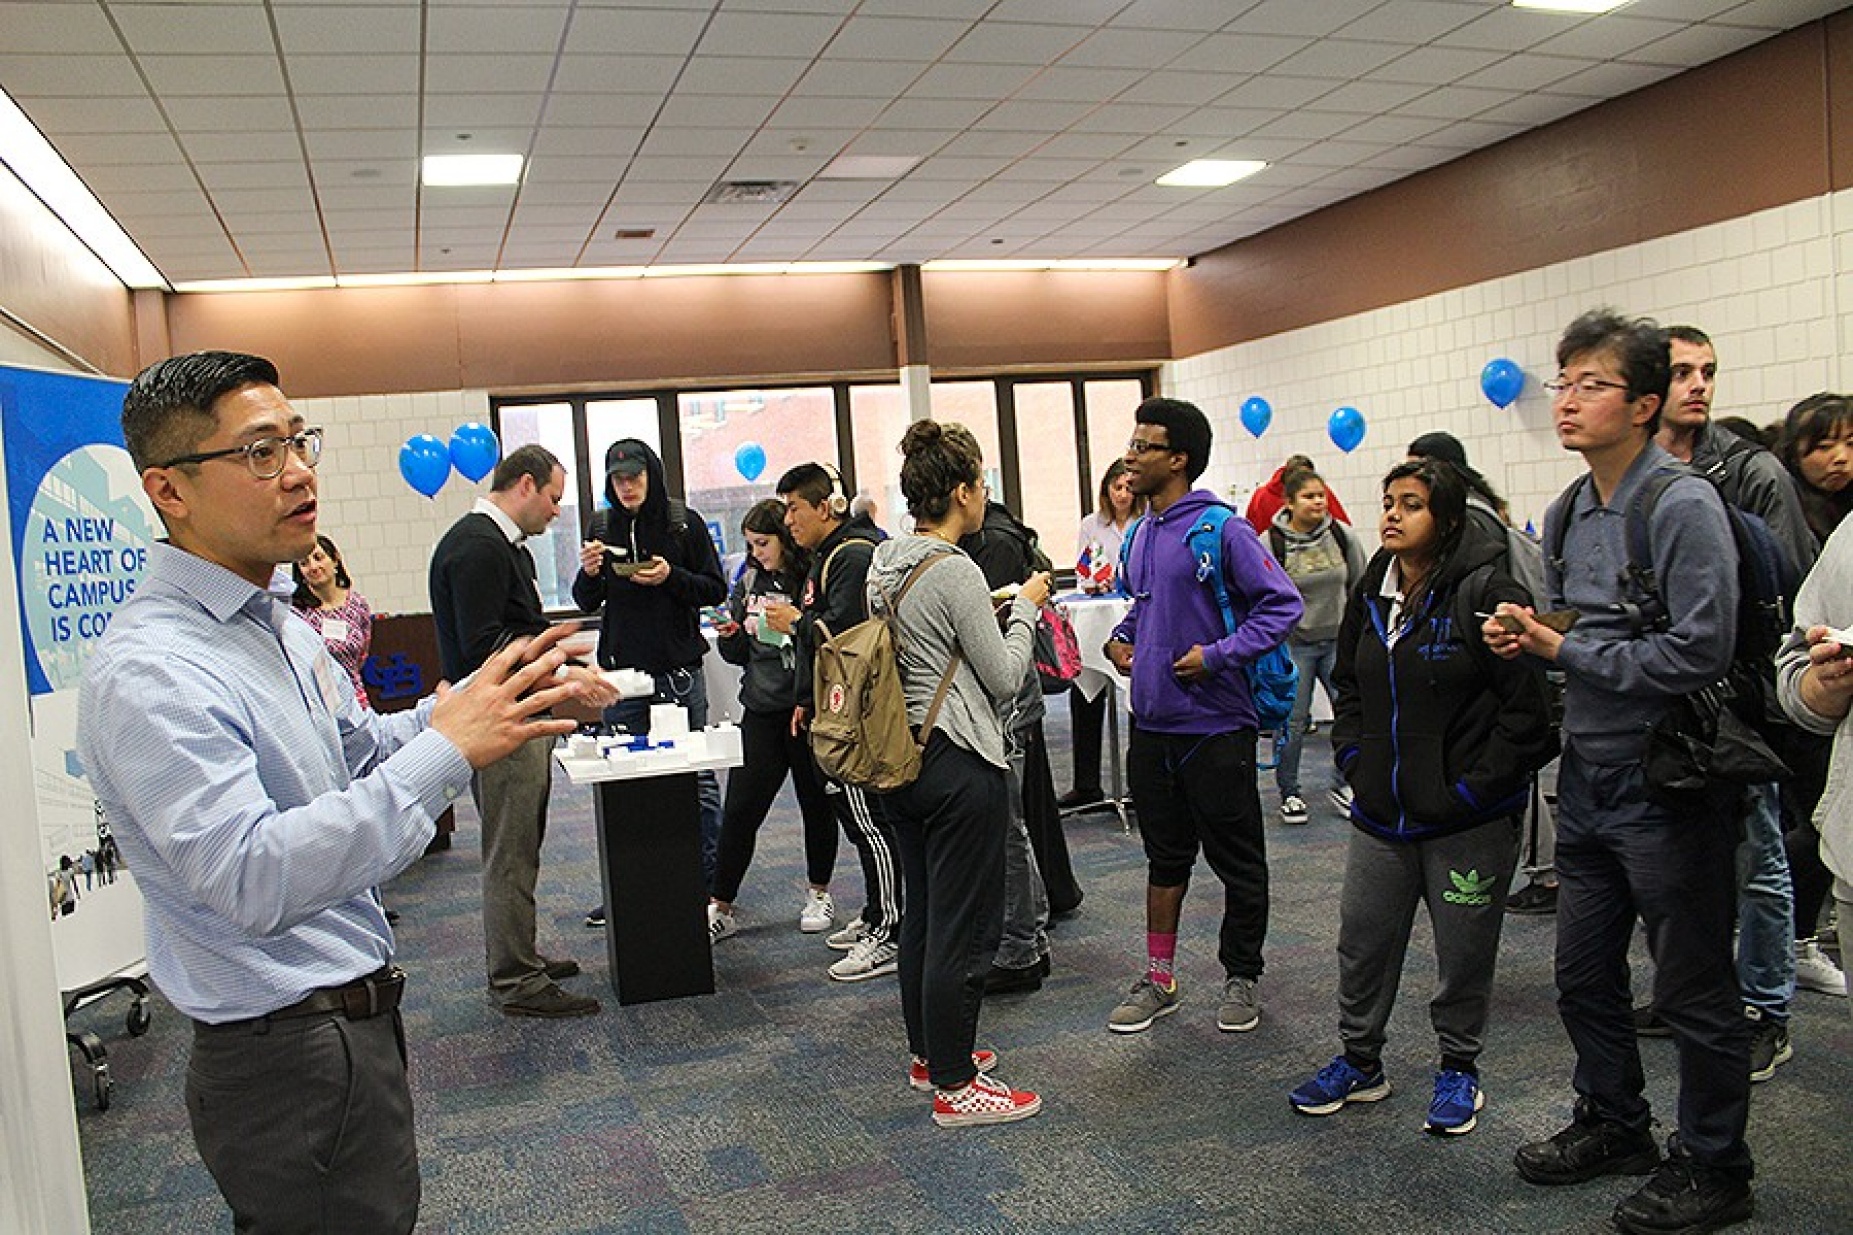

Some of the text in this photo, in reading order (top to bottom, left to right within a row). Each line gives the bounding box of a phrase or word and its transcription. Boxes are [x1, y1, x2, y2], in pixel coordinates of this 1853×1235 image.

[43, 517, 114, 542] A NEW
[45, 547, 147, 576] HEART OF
[51, 611, 113, 642] IS CO
